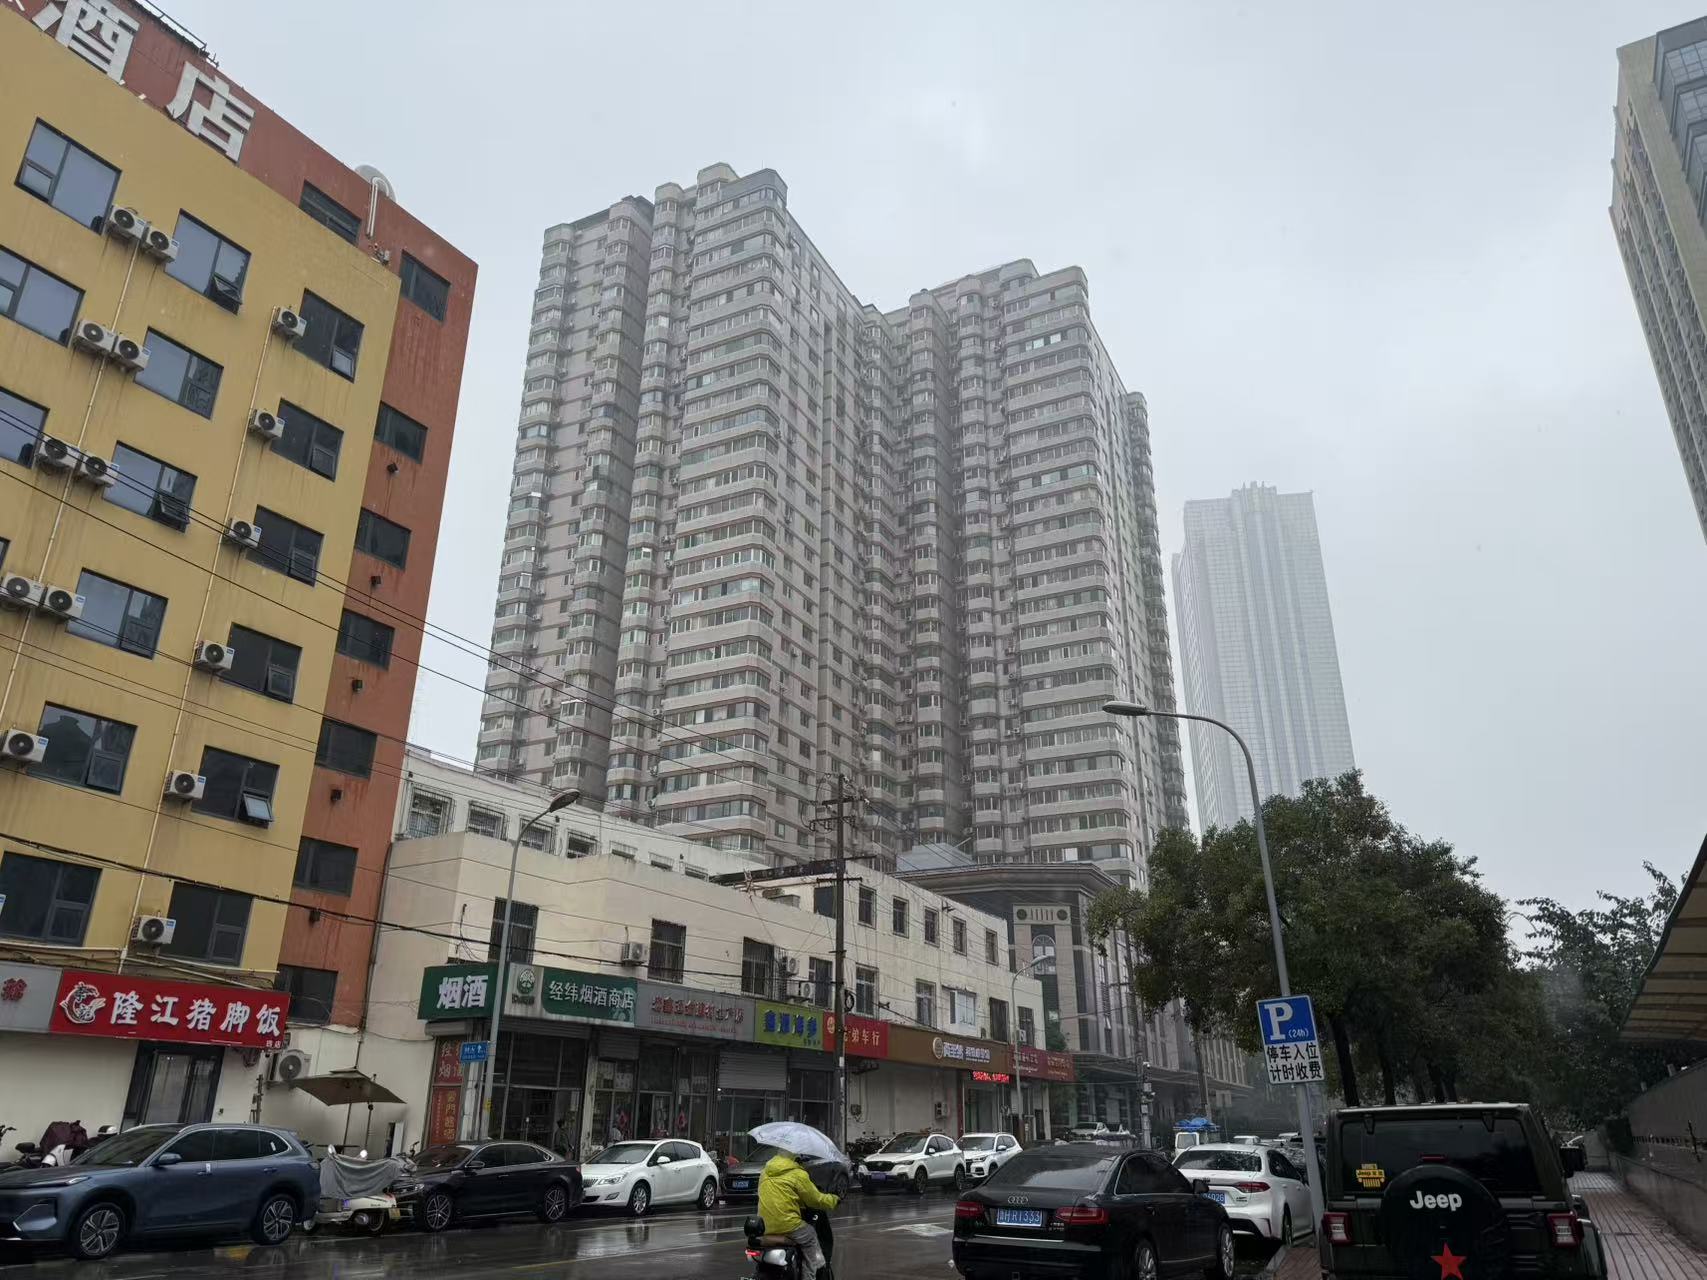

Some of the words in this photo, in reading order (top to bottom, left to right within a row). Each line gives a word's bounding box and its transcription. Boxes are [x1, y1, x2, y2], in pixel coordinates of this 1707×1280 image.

[437, 975, 489, 1009] 烟酒
[549, 980, 634, 1009] 经纬烟酒商店
[110, 990, 280, 1037] 隆江猪脚饭
[1264, 1002, 1293, 1040] P
[1266, 1042, 1319, 1063] 停车入位
[1269, 1061, 1322, 1081] 计时收费
[1410, 1190, 1463, 1212] Jeep
